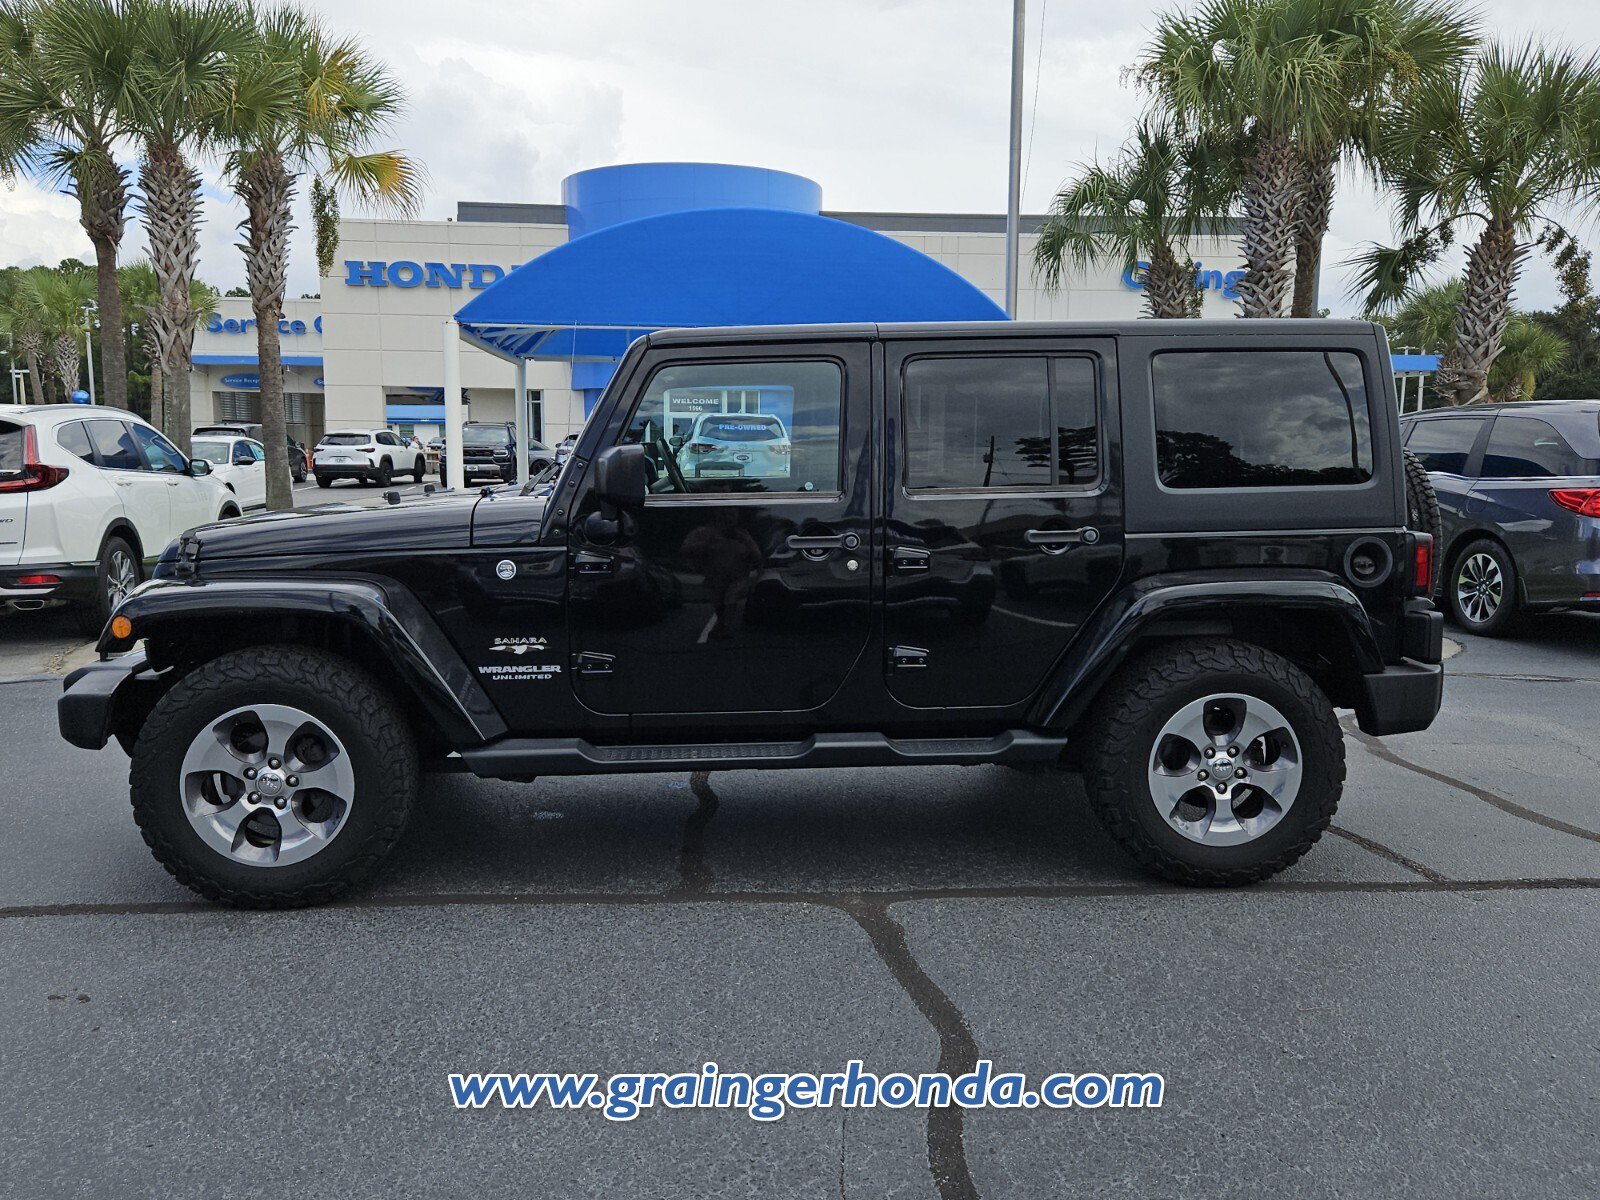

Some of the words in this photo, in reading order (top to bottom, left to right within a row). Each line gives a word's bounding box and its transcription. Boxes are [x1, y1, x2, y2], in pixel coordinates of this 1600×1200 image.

[344, 260, 521, 289] HOND
[719, 423, 767, 431] PRE-OWNED
[494, 637, 547, 645] SAHARA
[478, 665, 562, 674] WRANGLER
